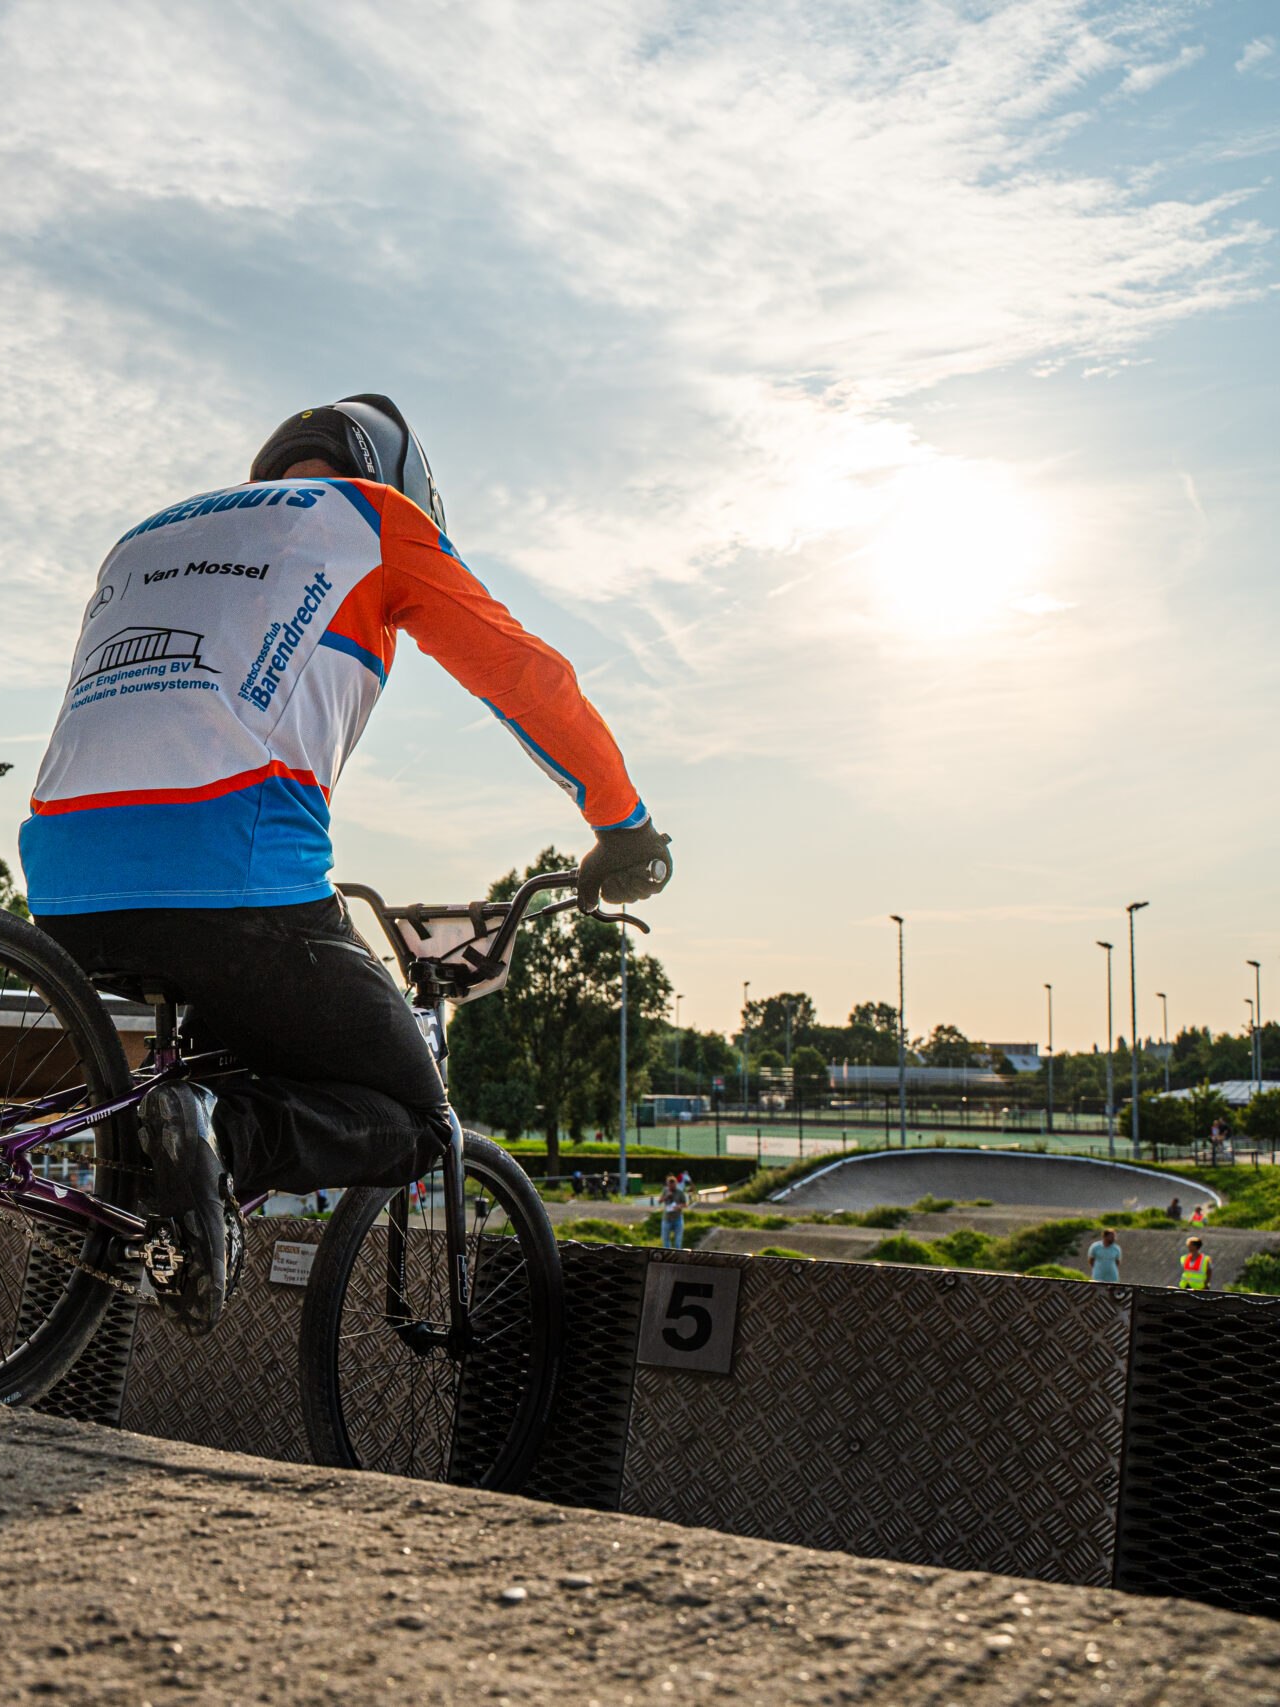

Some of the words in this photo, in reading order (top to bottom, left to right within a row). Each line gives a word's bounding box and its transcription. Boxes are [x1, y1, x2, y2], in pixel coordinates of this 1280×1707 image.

[143, 568, 179, 585] Van
[184, 560, 270, 580] Mossel
[240, 621, 281, 696] FietsCrossClub
[250, 572, 333, 710] Barendrecht
[71, 688, 117, 710] Modulaire
[120, 679, 220, 696] bouwsystemen
[73, 681, 95, 697] Aker
[96, 664, 167, 686] Engineering
[170, 661, 192, 673] BV
[85, 1109, 113, 1125] CRUISER
[662, 1281, 714, 1352] 5
